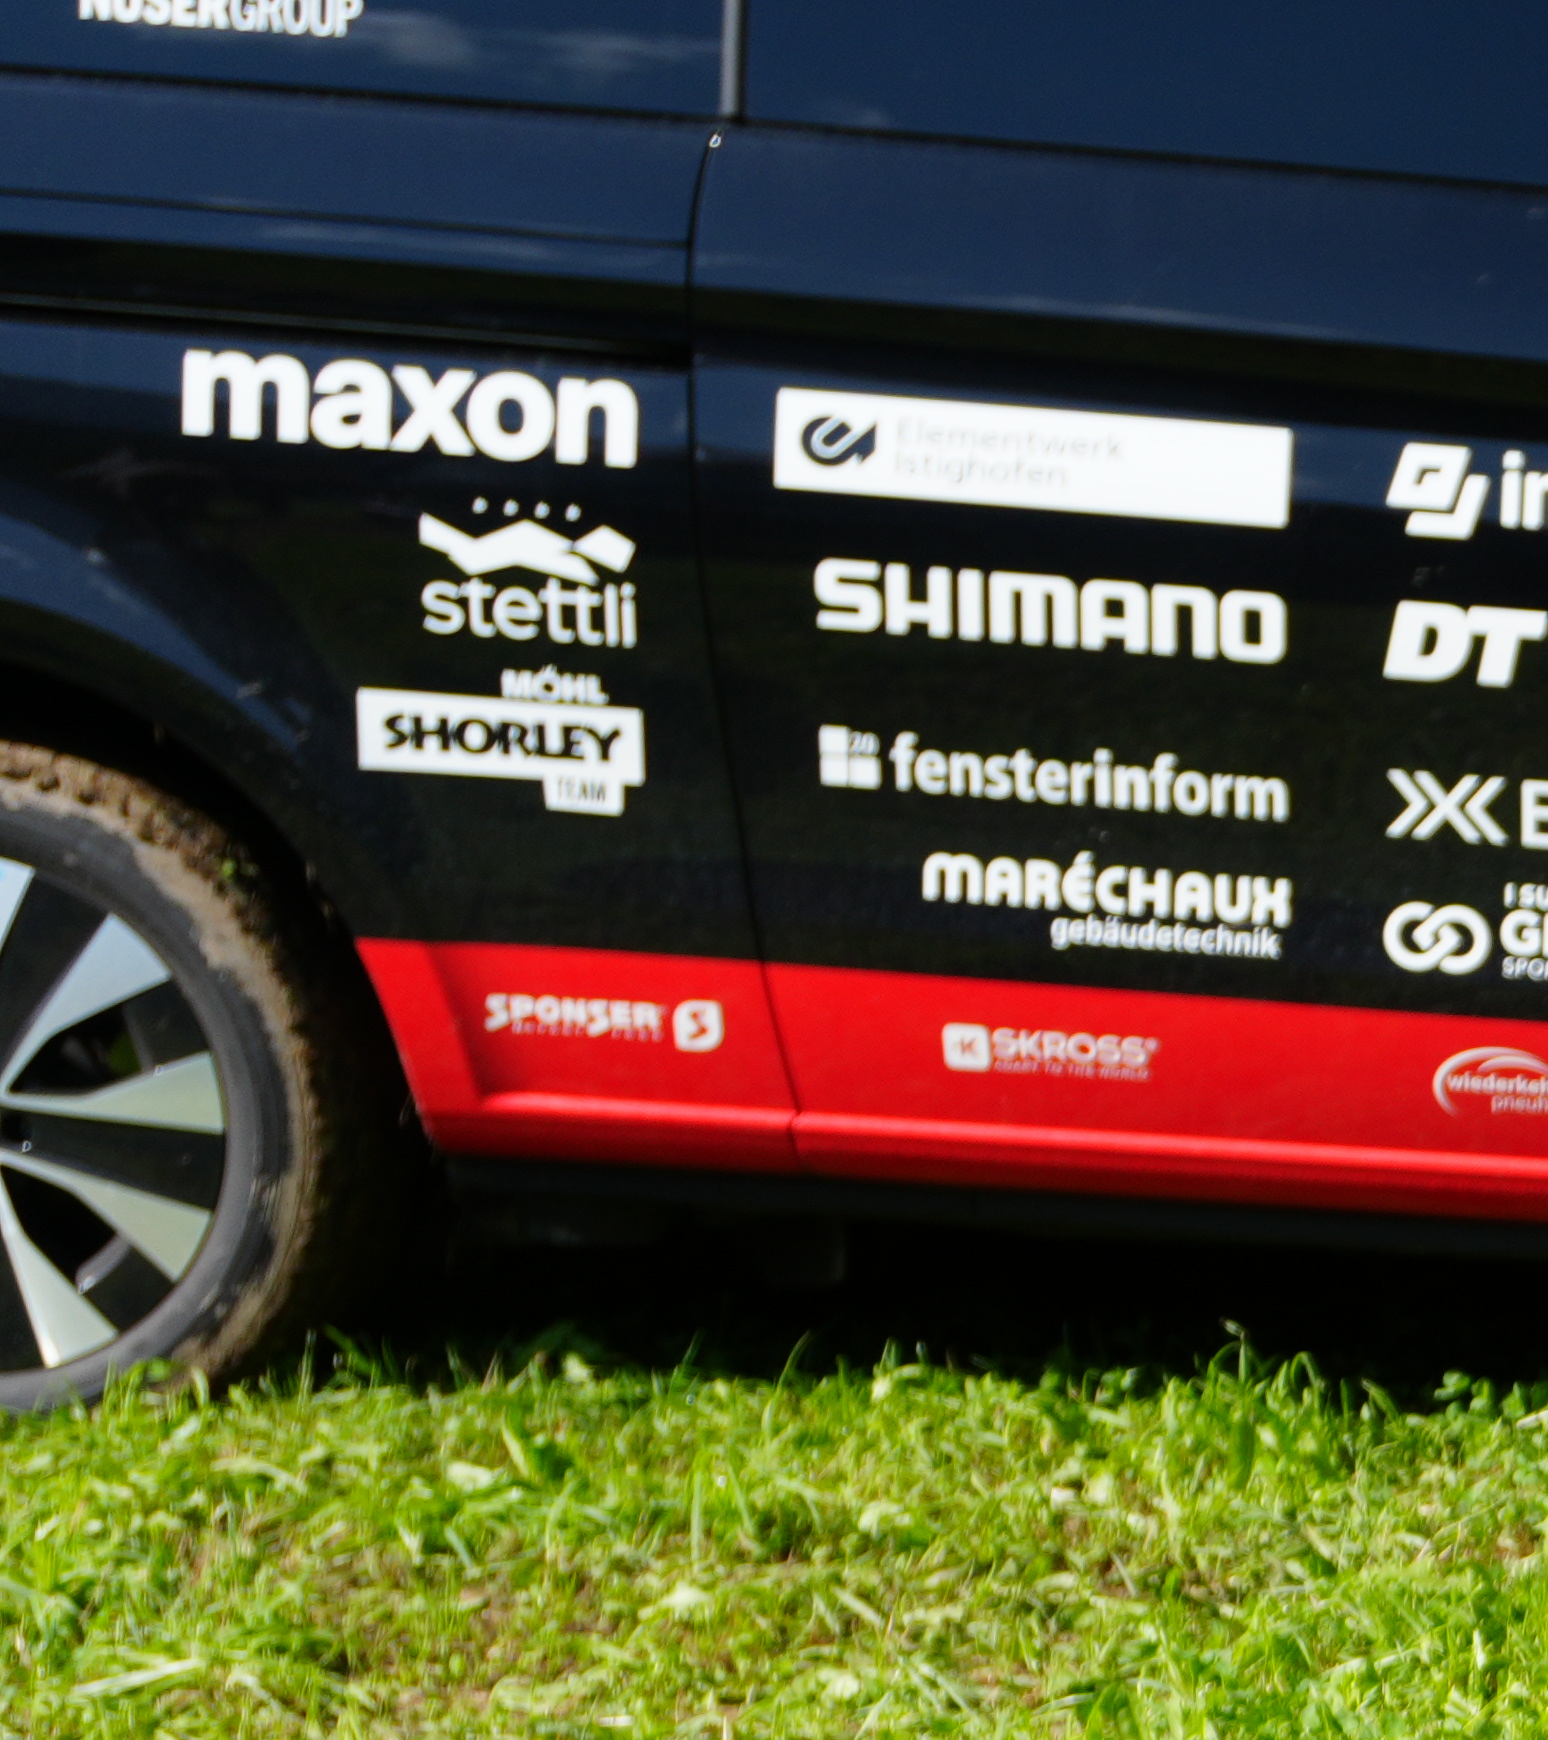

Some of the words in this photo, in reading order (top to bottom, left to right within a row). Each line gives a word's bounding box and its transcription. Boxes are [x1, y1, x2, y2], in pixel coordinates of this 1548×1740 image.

[181, 348, 640, 469] maxon
[421, 577, 638, 650] stettli
[814, 557, 1287, 665] SHIMANO
[500, 664, 609, 706] MÖHL
[383, 713, 622, 763] SHORLEY
[889, 731, 1291, 823] fensterinform
[922, 850, 1292, 928] MARÉCHAUX
[1051, 915, 1284, 961] gebäudetechnik
[484, 992, 664, 1037] SPONSER
